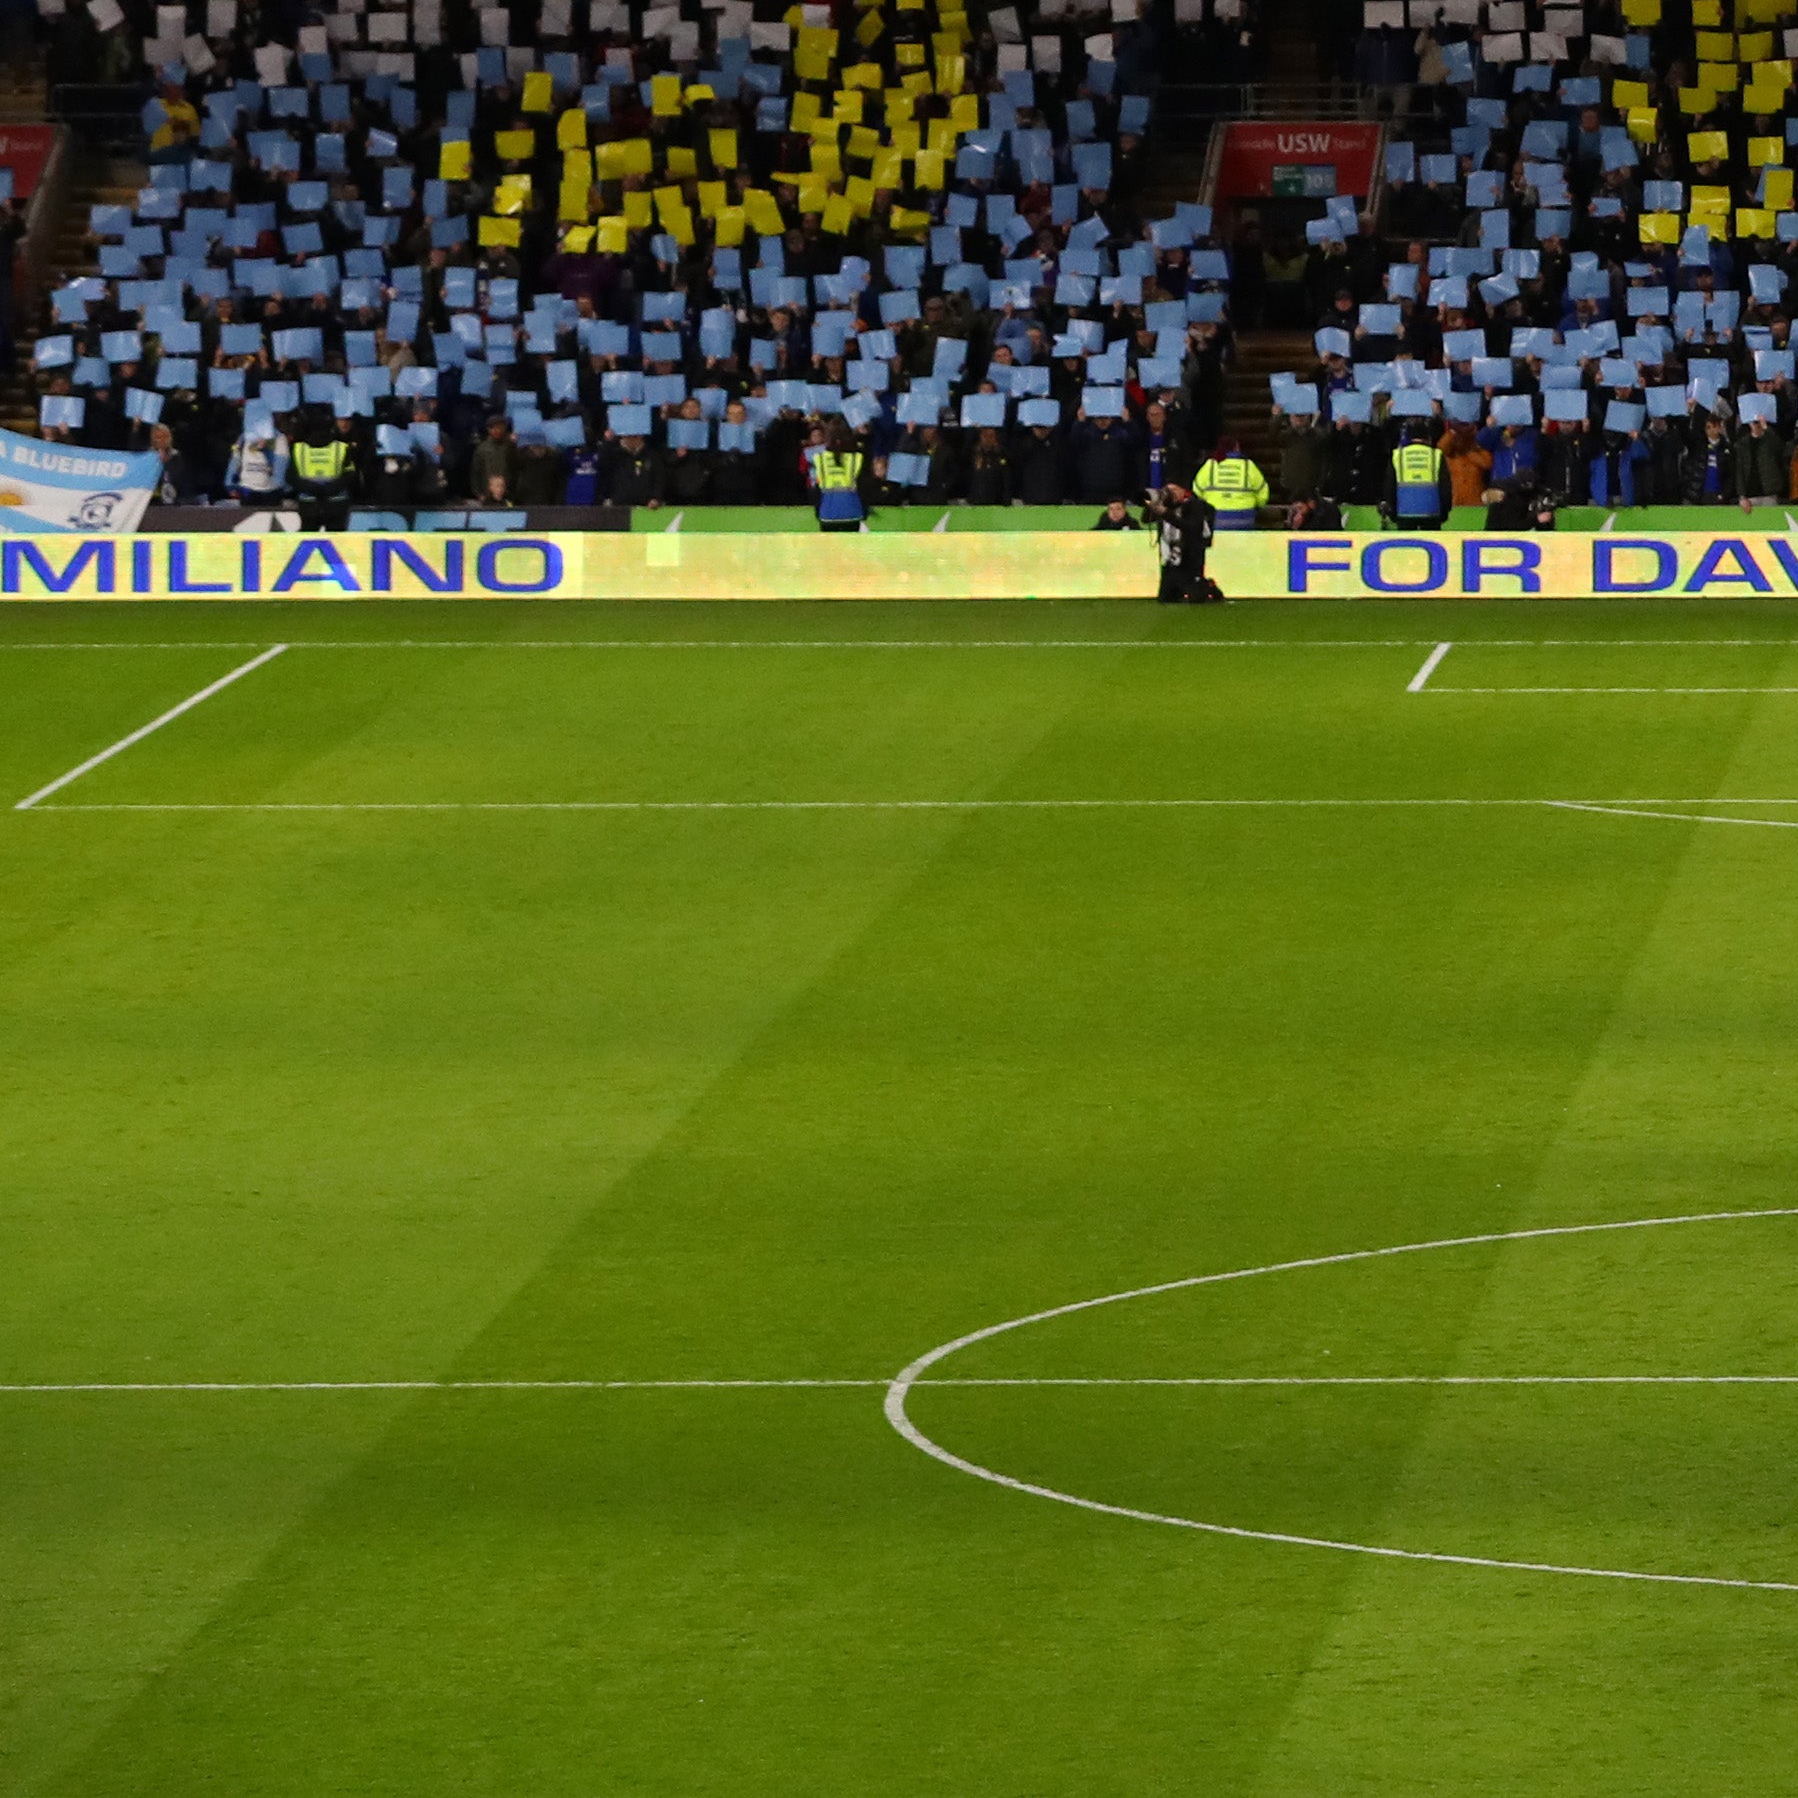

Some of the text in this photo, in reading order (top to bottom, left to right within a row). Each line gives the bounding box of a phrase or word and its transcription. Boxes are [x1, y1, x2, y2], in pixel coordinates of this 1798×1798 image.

[1277, 133, 1331, 153] USW
[12, 446, 129, 479] BLUEBIRD
[1289, 539, 1541, 592] FOR
